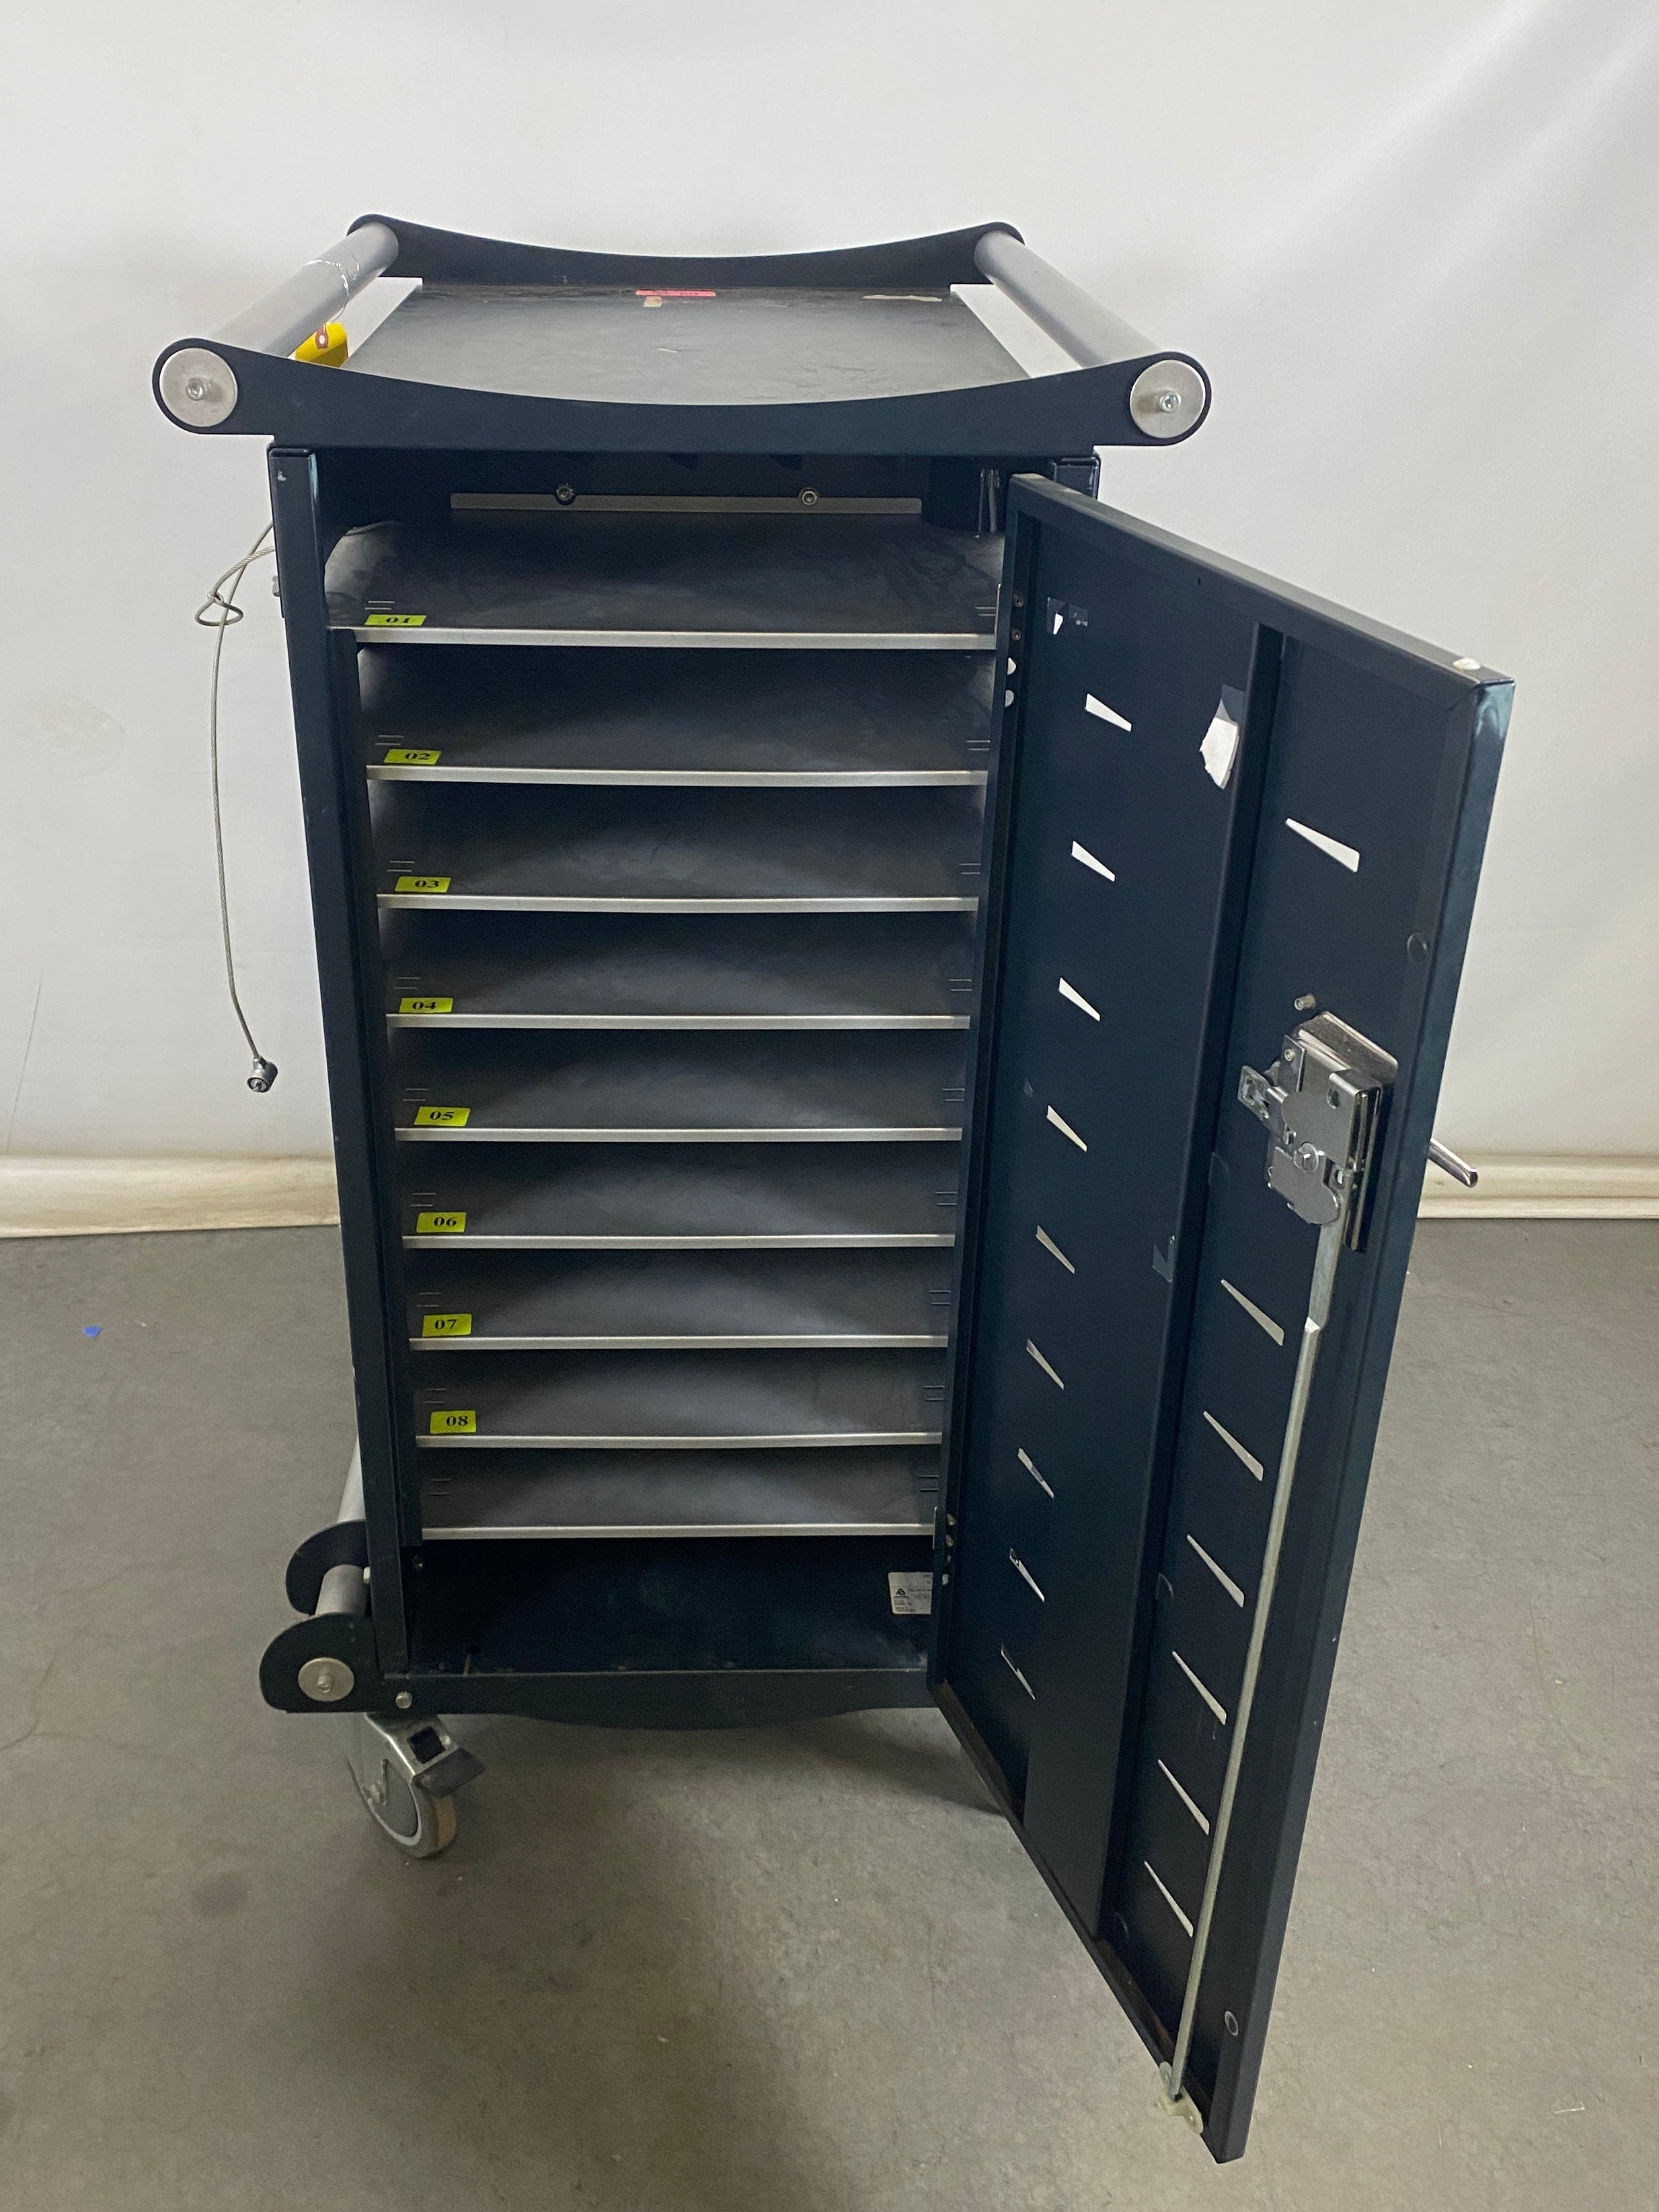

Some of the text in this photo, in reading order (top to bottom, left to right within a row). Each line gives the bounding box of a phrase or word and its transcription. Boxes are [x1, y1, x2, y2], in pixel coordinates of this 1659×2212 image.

[414, 880, 440, 888] 03
[412, 1001, 437, 1010] 04
[430, 1110, 455, 1120] 05
[433, 1216, 457, 1227] 06
[434, 1319, 458, 1330] 07
[446, 1415, 469, 1426] 08
